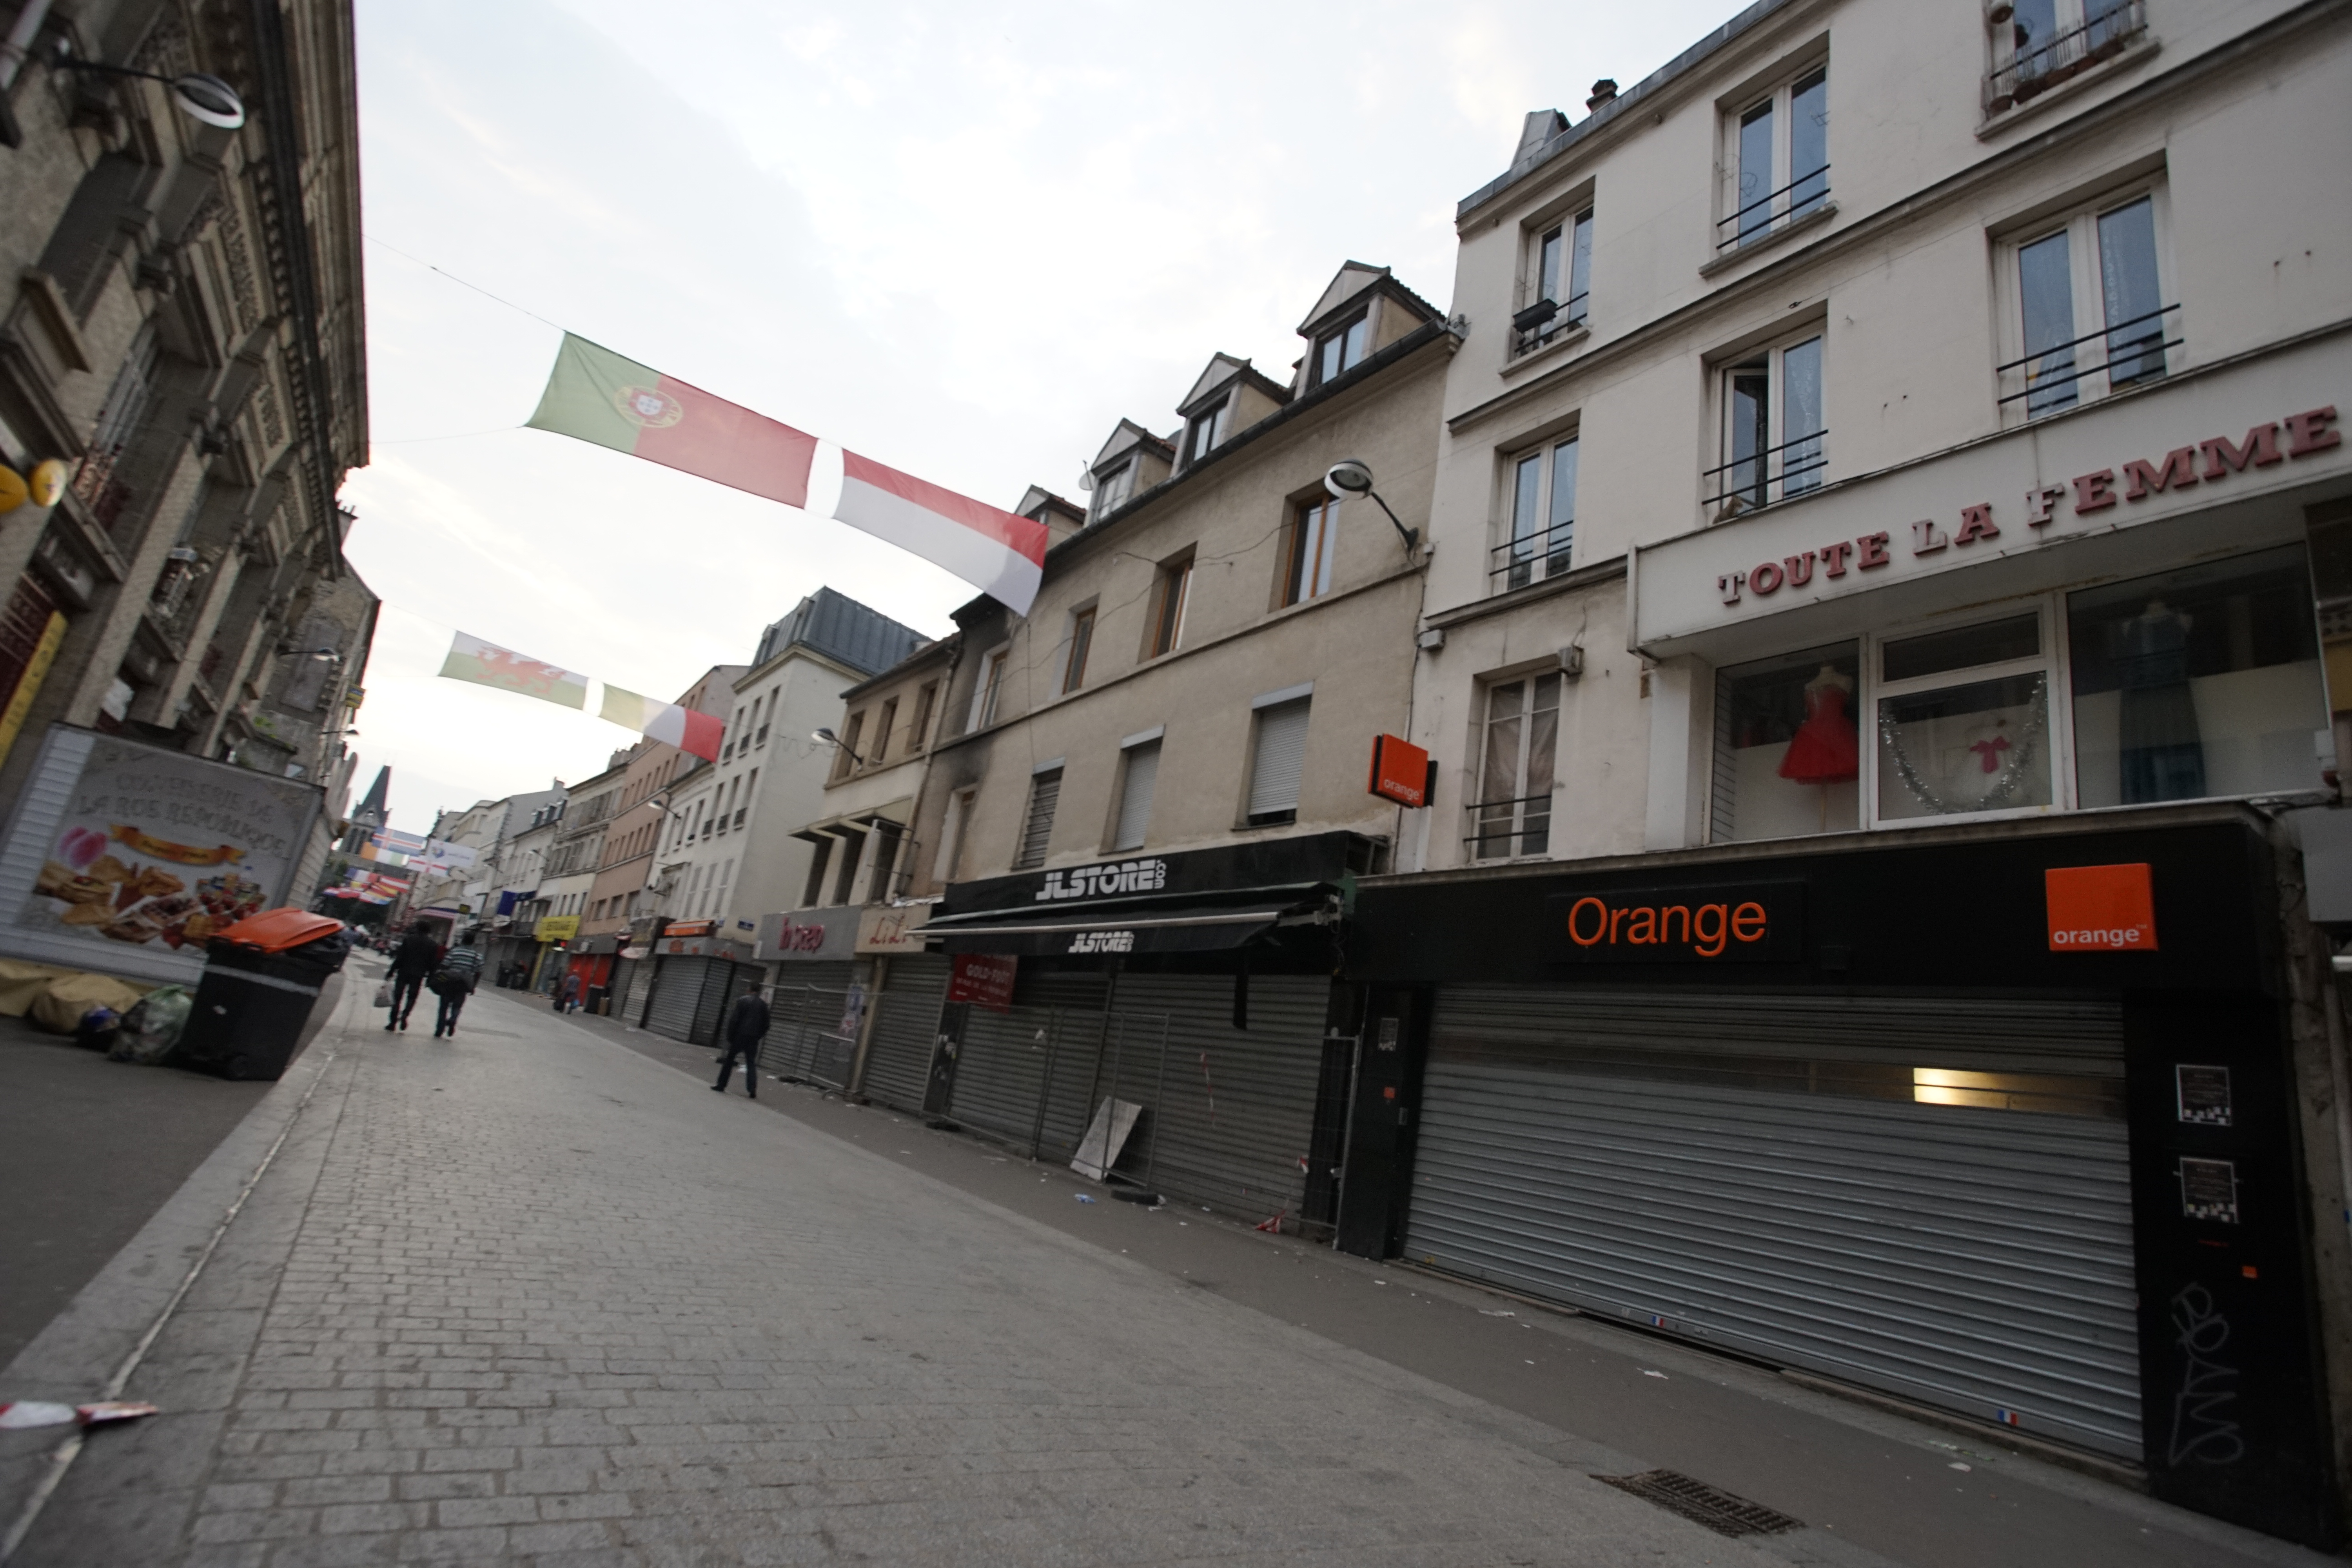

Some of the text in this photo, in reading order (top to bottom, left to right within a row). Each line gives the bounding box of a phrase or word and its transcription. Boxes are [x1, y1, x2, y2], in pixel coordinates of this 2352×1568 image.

[1718, 405, 2341, 605] TOUTE LA FEMME
[1383, 778, 1419, 800] orange
[1568, 897, 1766, 957] Orange
[2053, 928, 2140, 947] orange
